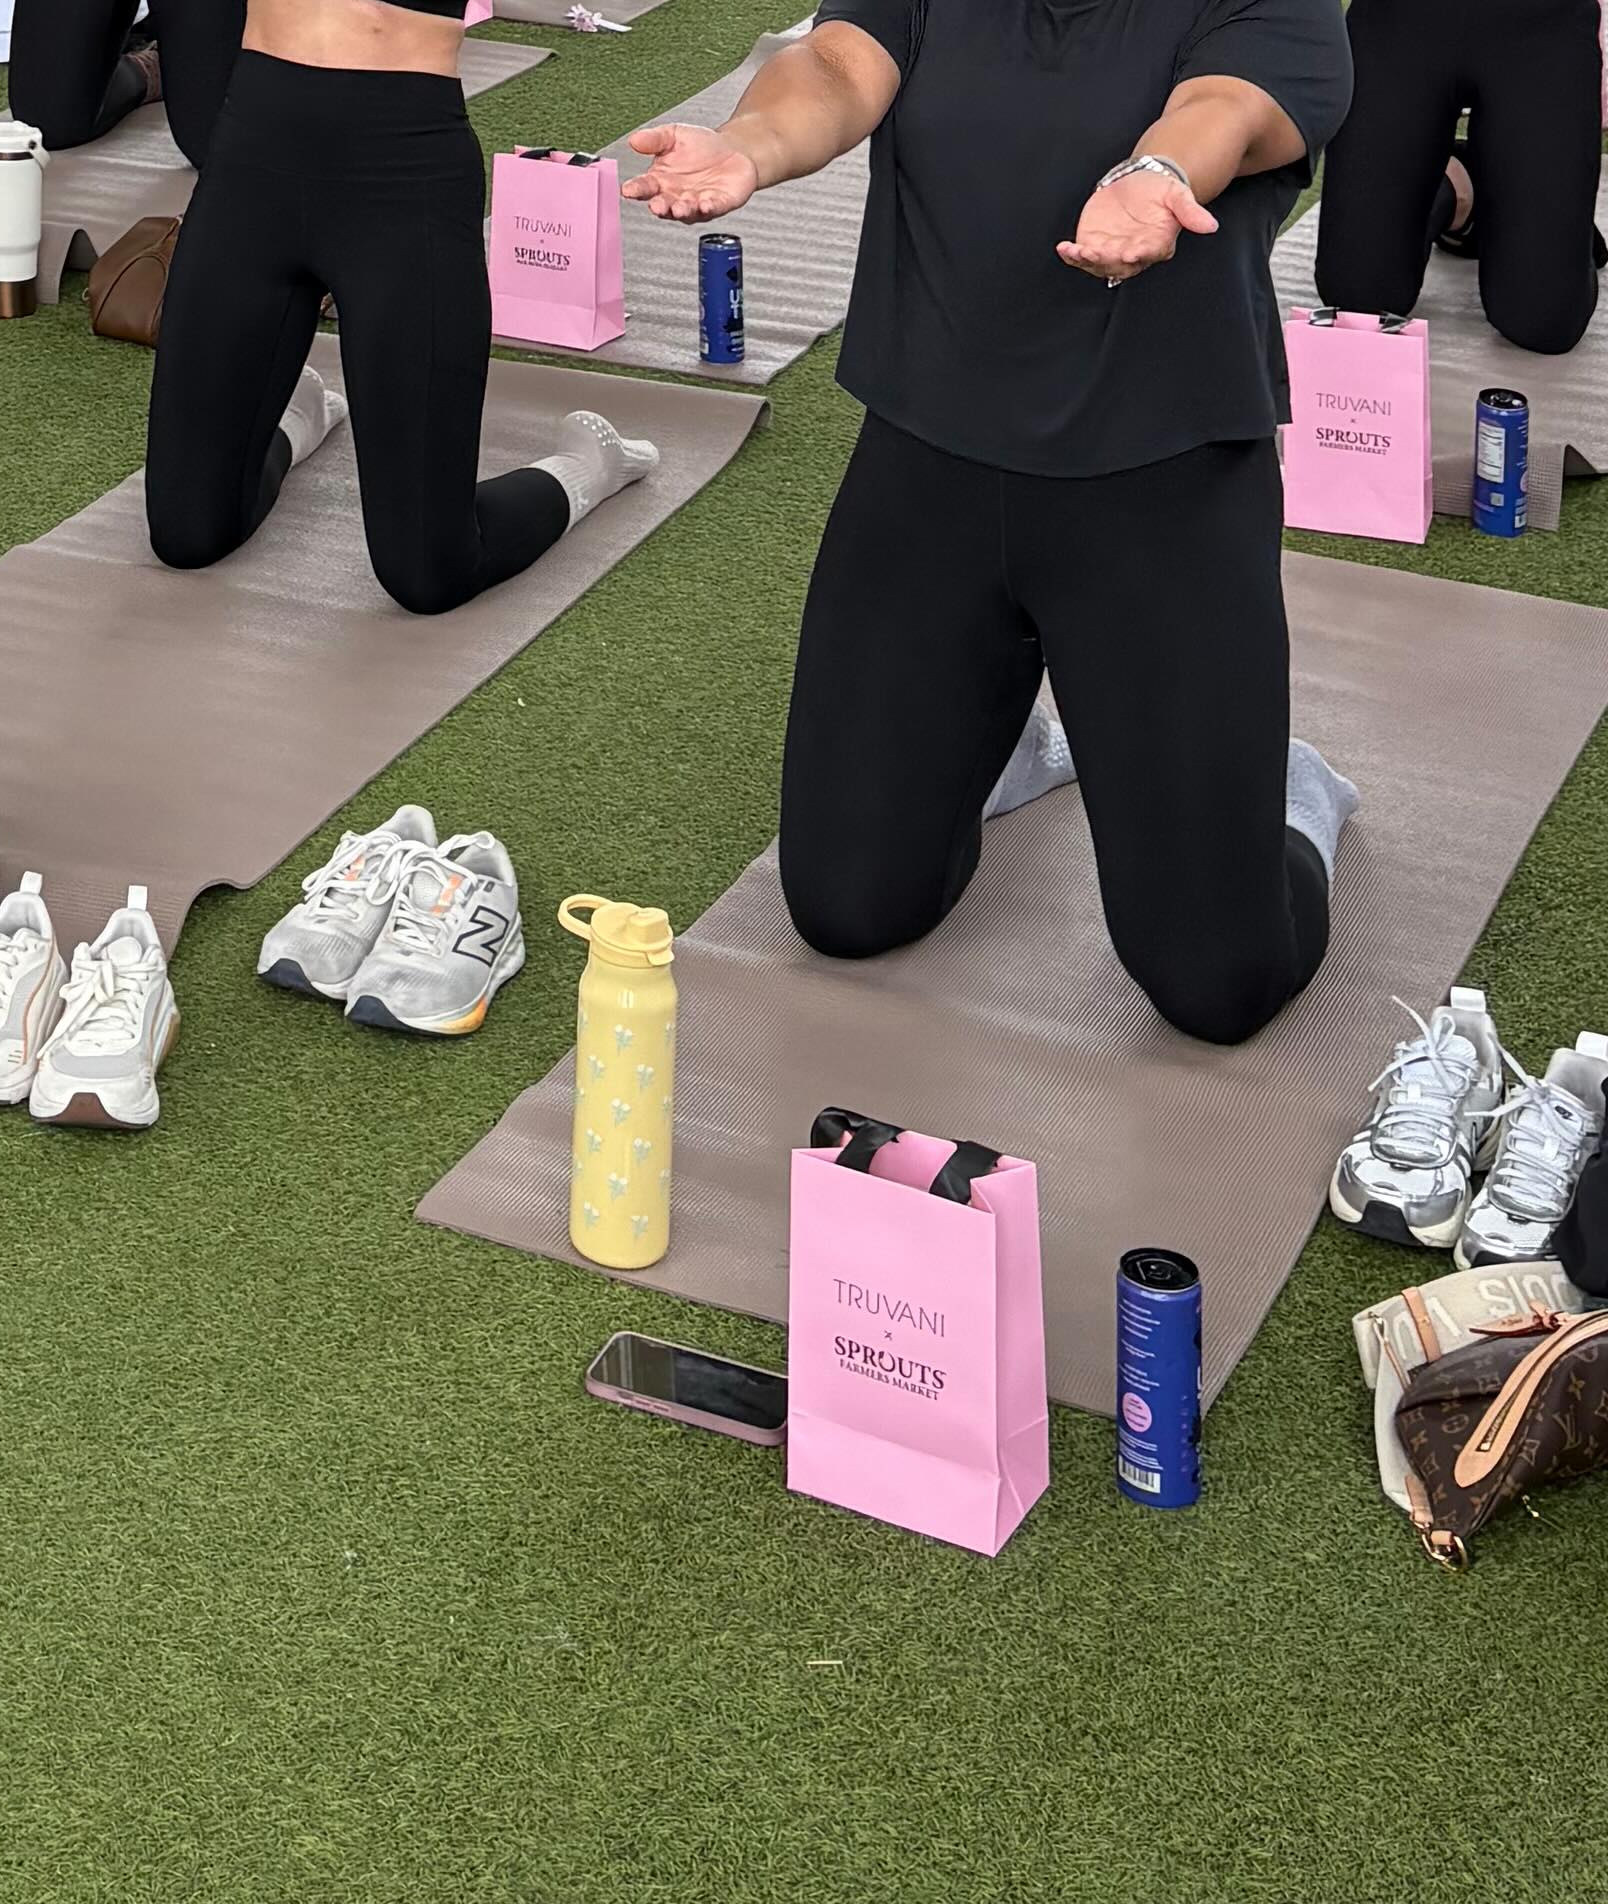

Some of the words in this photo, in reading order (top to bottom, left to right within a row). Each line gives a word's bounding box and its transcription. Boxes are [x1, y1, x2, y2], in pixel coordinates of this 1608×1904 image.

[513, 215, 572, 238] TRUVANI
[1315, 392, 1392, 417] TRUVANI
[1315, 426, 1392, 448] SPROUTS
[832, 1278, 945, 1338] TRUVANI
[833, 1335, 947, 1390] SPROUTS
[839, 1358, 891, 1385] FARMERS
[892, 1376, 940, 1401] MARKET
